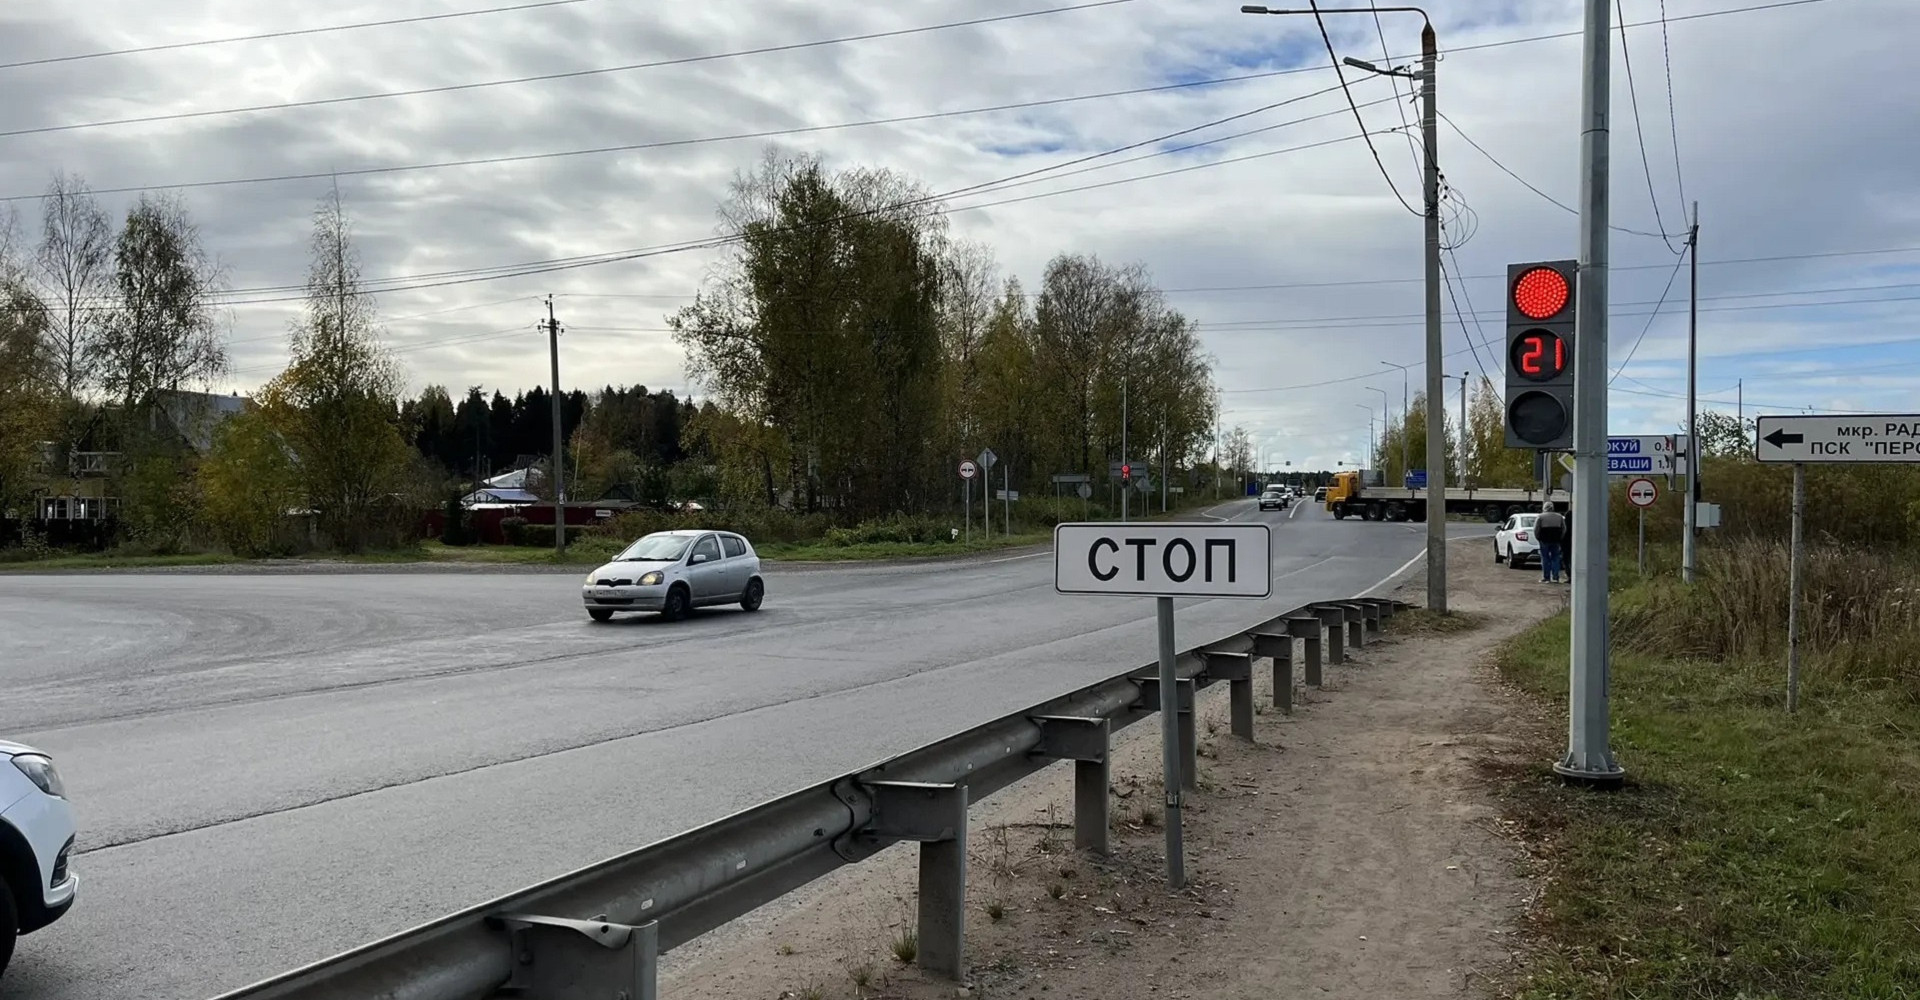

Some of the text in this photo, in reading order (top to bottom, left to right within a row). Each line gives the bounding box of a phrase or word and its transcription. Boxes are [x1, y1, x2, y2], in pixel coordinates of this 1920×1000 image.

[1522, 337, 1563, 374] 21
[1837, 426, 1878, 440] мкр.
[1811, 441, 1851, 455] ПСК
[1088, 537, 1236, 583] СТОП
